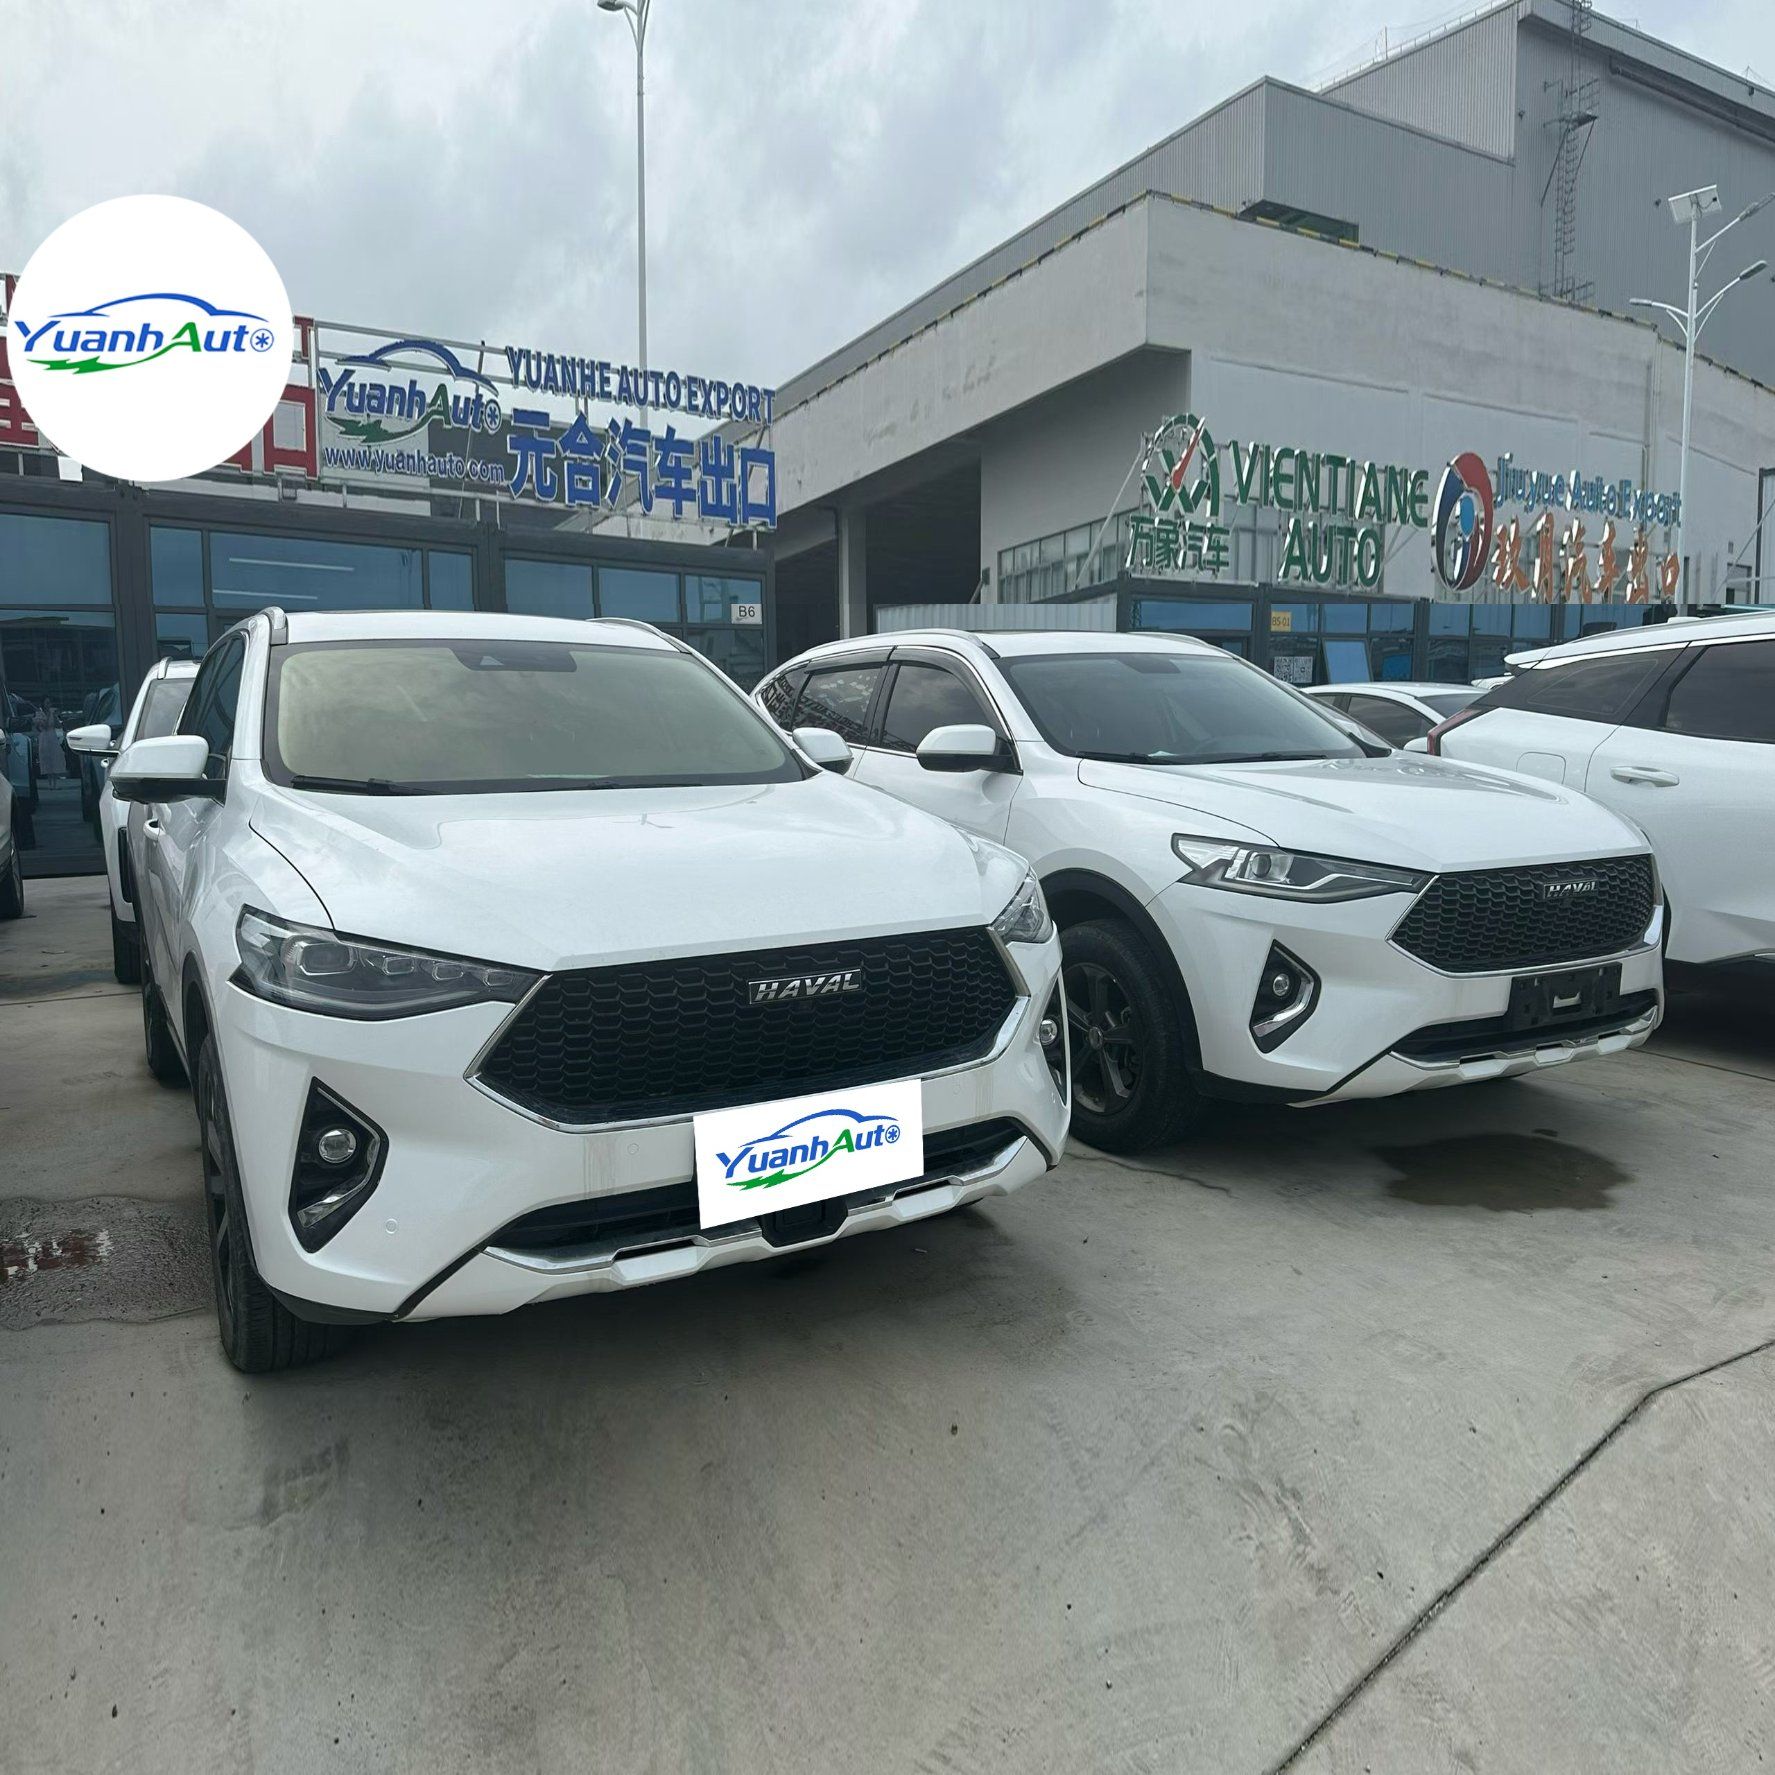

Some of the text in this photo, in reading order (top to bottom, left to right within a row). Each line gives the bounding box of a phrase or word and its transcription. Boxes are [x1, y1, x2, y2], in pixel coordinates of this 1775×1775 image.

[506, 346, 777, 425] YUANHE AUTO EXPORT
[506, 407, 777, 529] 元合汽车出口
[1229, 439, 1430, 528] VIENTIANE
[1564, 470, 1618, 516] Auto
[1126, 515, 1230, 573] 万象汽车
[1278, 518, 1382, 588] AUTO
[738, 605, 756, 618] B6
[754, 973, 860, 1002] HAVAL
